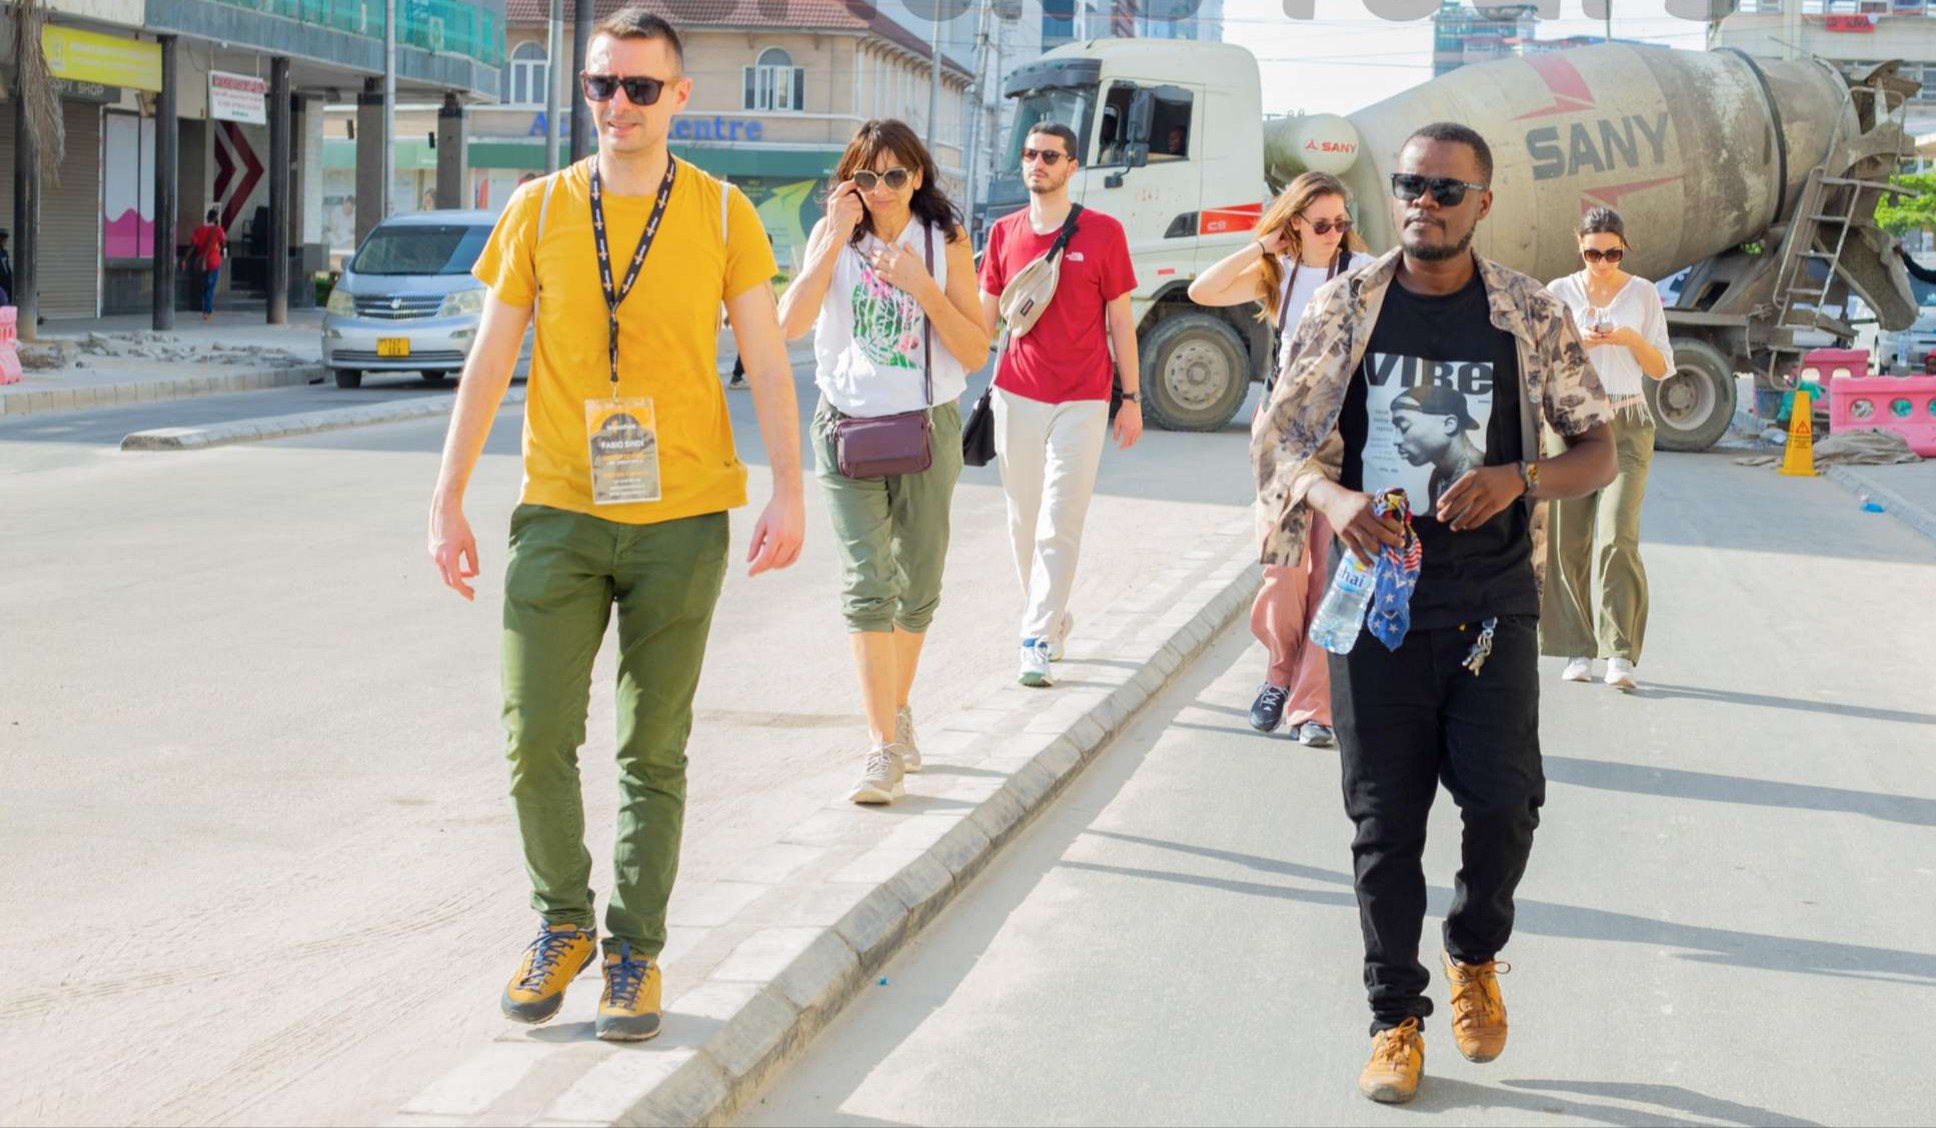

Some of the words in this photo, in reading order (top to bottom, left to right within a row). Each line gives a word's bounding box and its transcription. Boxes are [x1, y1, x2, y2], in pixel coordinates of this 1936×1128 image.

[77, 82, 105, 96] SHOP
[668, 114, 764, 141] entre
[1321, 141, 1357, 154] SANY
[1525, 111, 1669, 181] SANY
